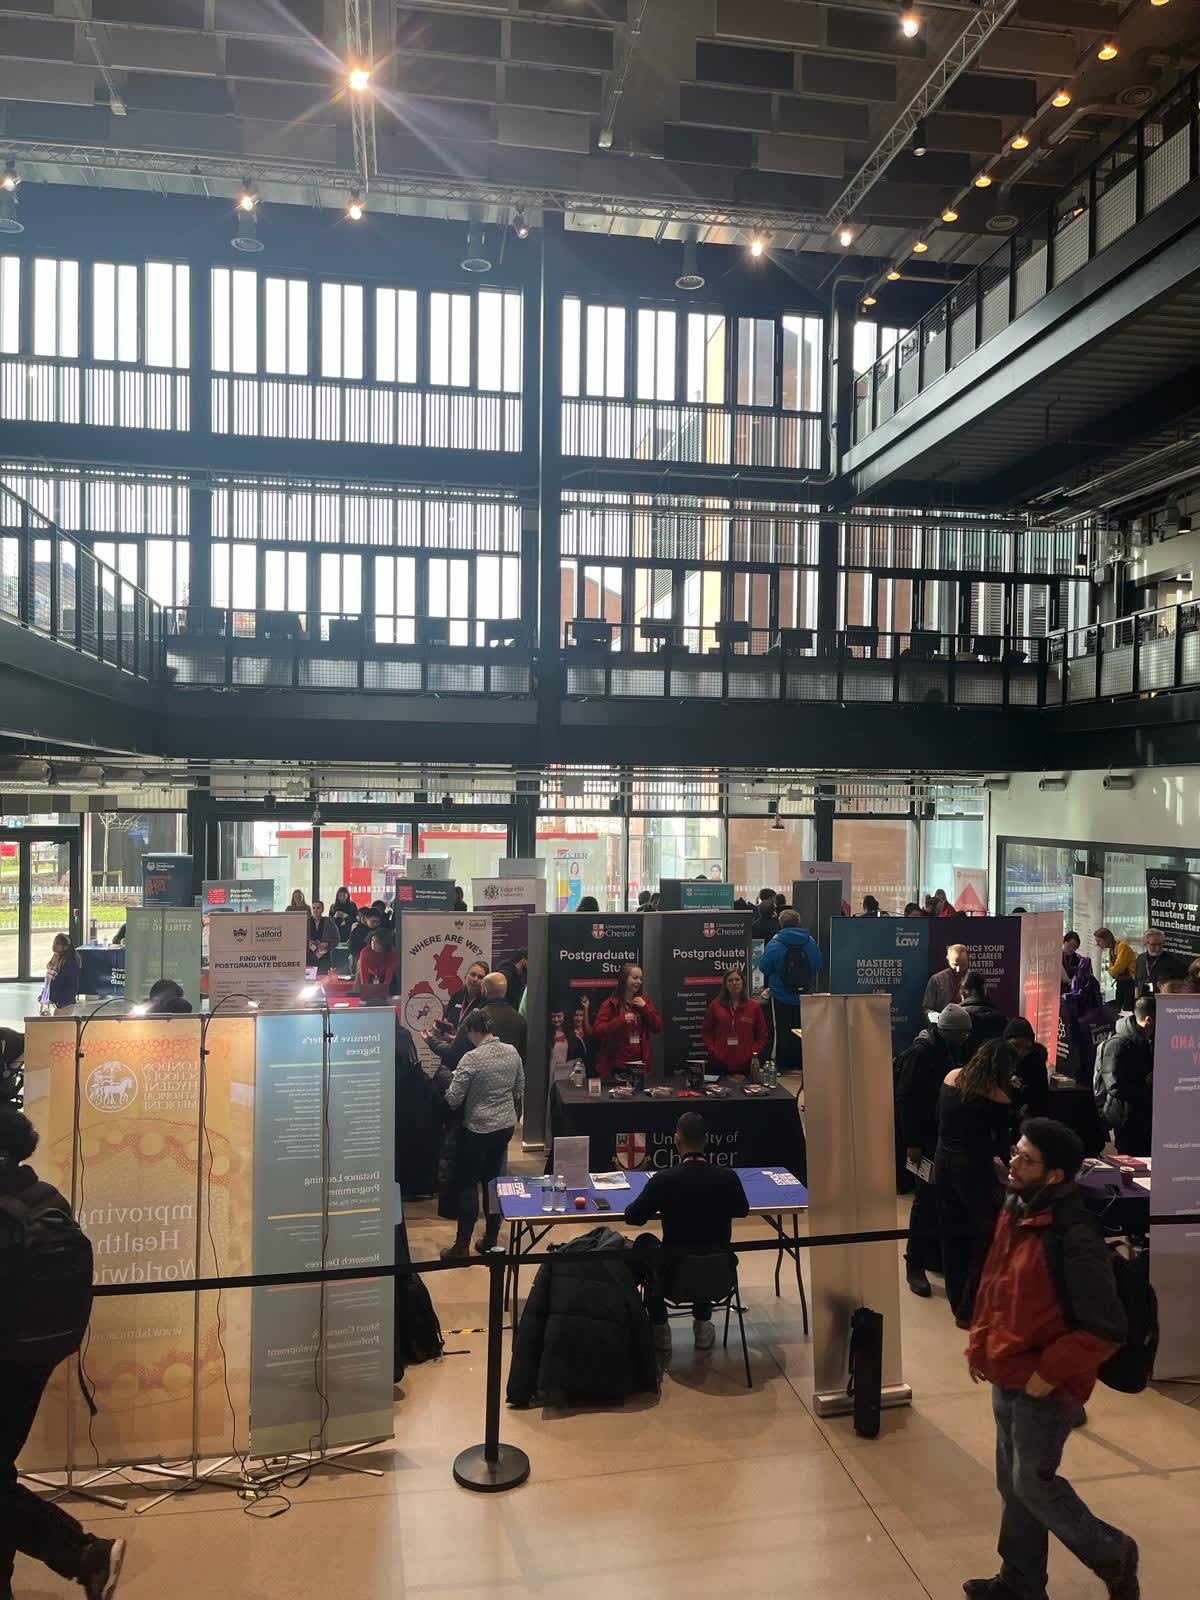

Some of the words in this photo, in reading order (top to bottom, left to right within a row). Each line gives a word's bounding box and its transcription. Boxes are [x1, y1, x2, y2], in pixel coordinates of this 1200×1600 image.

[1151, 898, 1177, 910] Study
[1178, 902, 1199, 912] your
[1151, 910, 1185, 920] masters
[1187, 911, 1196, 922] in
[1151, 918, 1200, 932] Manchester
[255, 930, 282, 938] Salford
[605, 929, 635, 938] Chester
[716, 927, 745, 936] Chester
[408, 934, 442, 957] WHERE
[443, 934, 464, 945] ARE
[465, 939, 484, 957] WE?
[895, 936, 920, 947] Law
[984, 944, 1005, 952] YOUR
[258, 954, 277, 962] YOUR
[560, 950, 635, 963] Postgraduate
[673, 948, 745, 961] Postgraduate
[977, 952, 1002, 960] CAREER
[602, 962, 621, 973] Stu
[714, 960, 746, 972] Study
[857, 959, 903, 968] MASTER'S
[857, 968, 903, 977] COURSES
[857, 977, 891, 985] AVAILABLE
[726, 1131, 739, 1143] of
[653, 1149, 738, 1169] Chter
